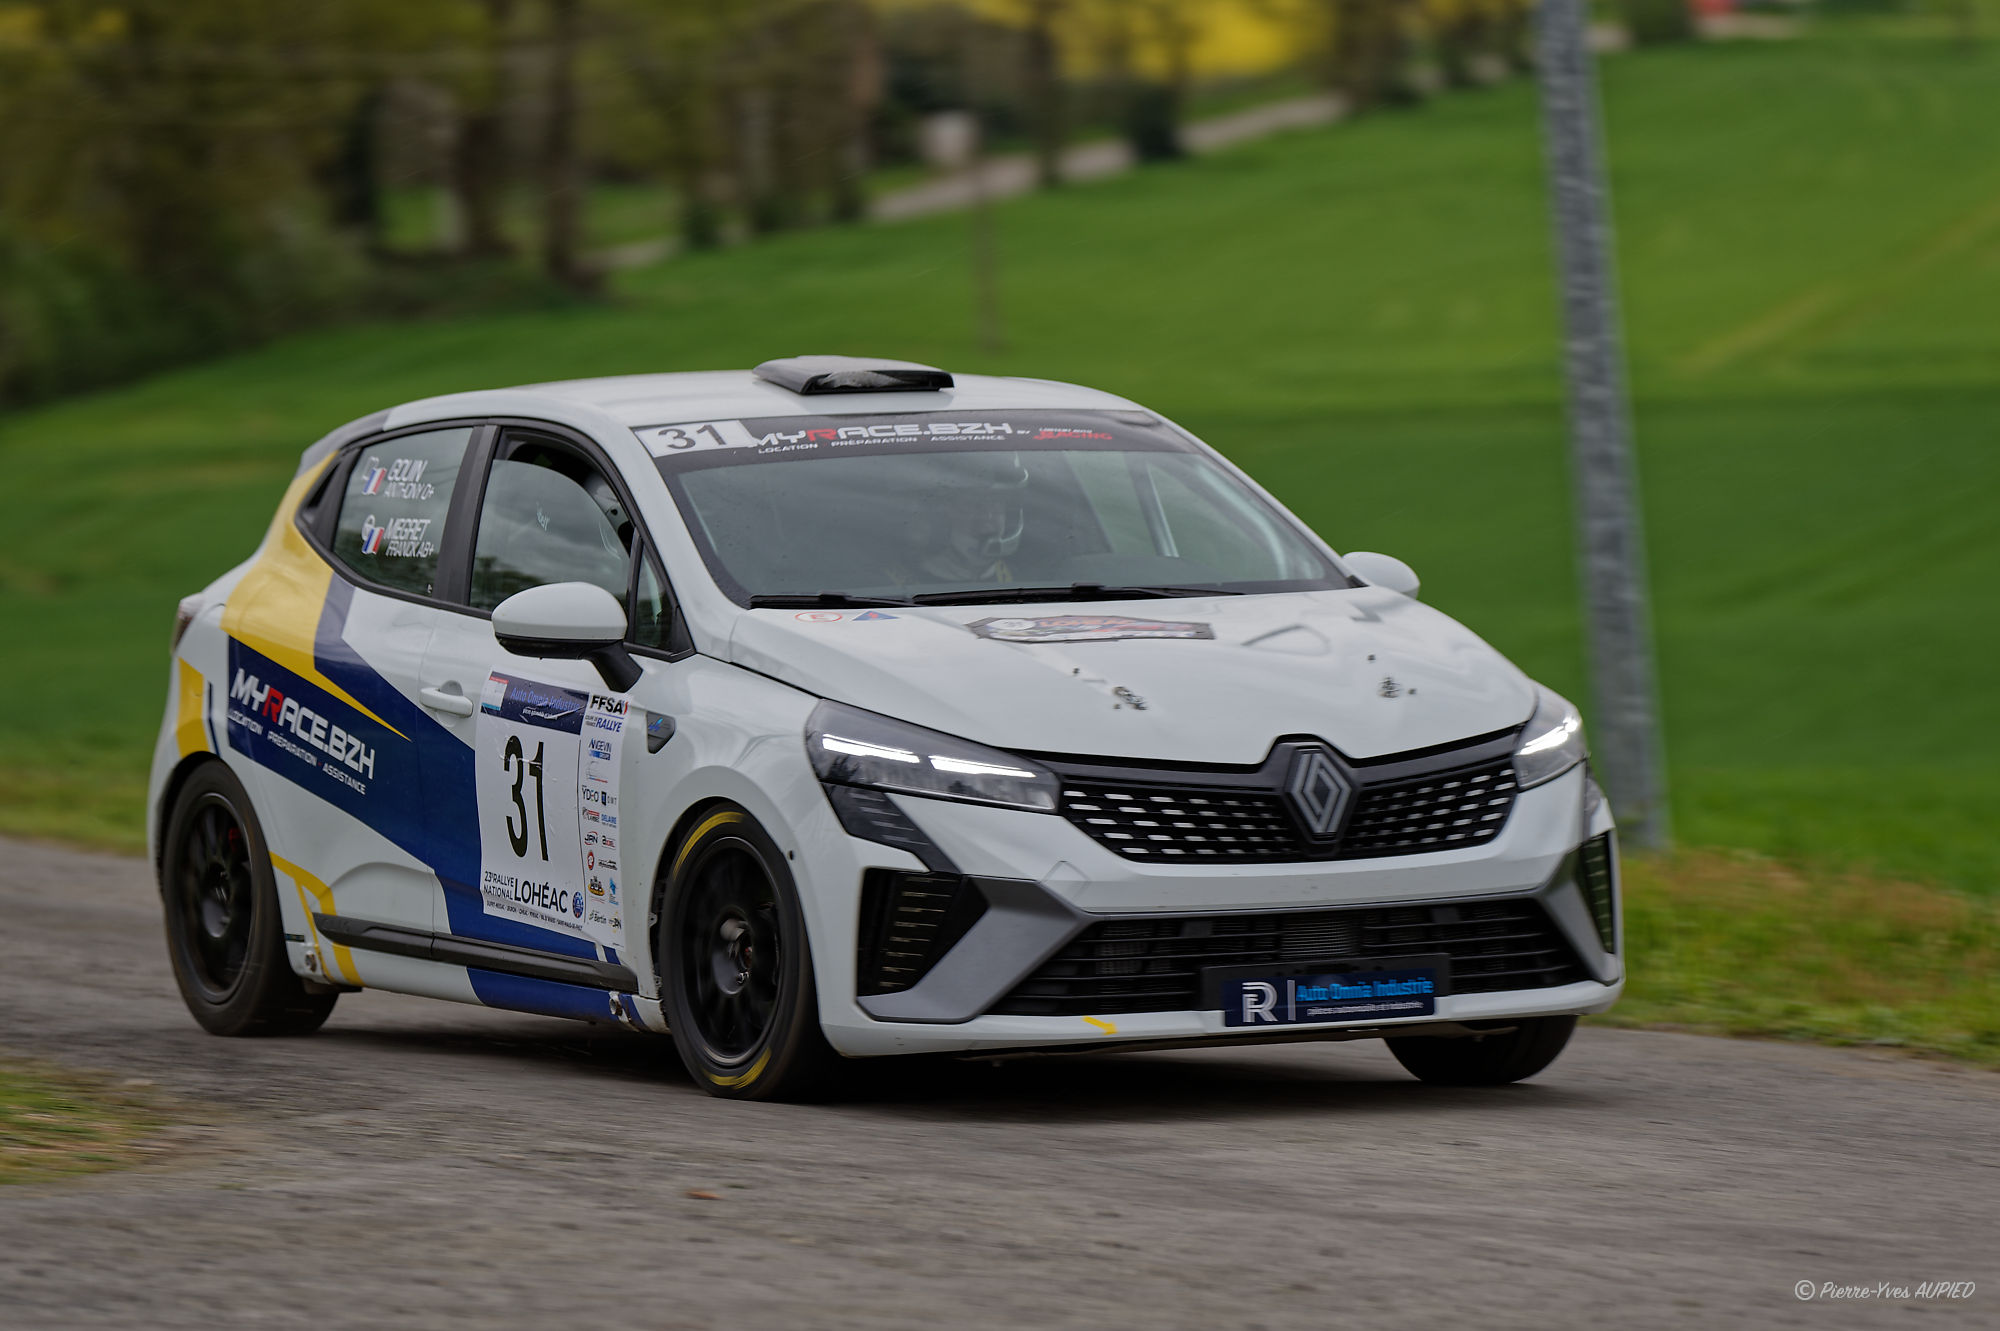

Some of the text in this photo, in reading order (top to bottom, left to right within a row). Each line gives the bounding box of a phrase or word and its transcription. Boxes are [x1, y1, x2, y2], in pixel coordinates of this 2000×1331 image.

[657, 424, 727, 449] 31
[758, 443, 819, 454] LOCATION
[509, 687, 527, 702] Auto
[589, 695, 623, 715] FFSA
[230, 667, 375, 780] MYRACE.BZH
[596, 717, 623, 733] RALLYE
[227, 709, 366, 795] LOCATION PRÉPARATION ASSISTANCE
[503, 735, 549, 862] 31
[493, 872, 514, 888] RALLYE
[483, 884, 513, 901] NATIONAL
[514, 878, 568, 914] LOHÉAC
